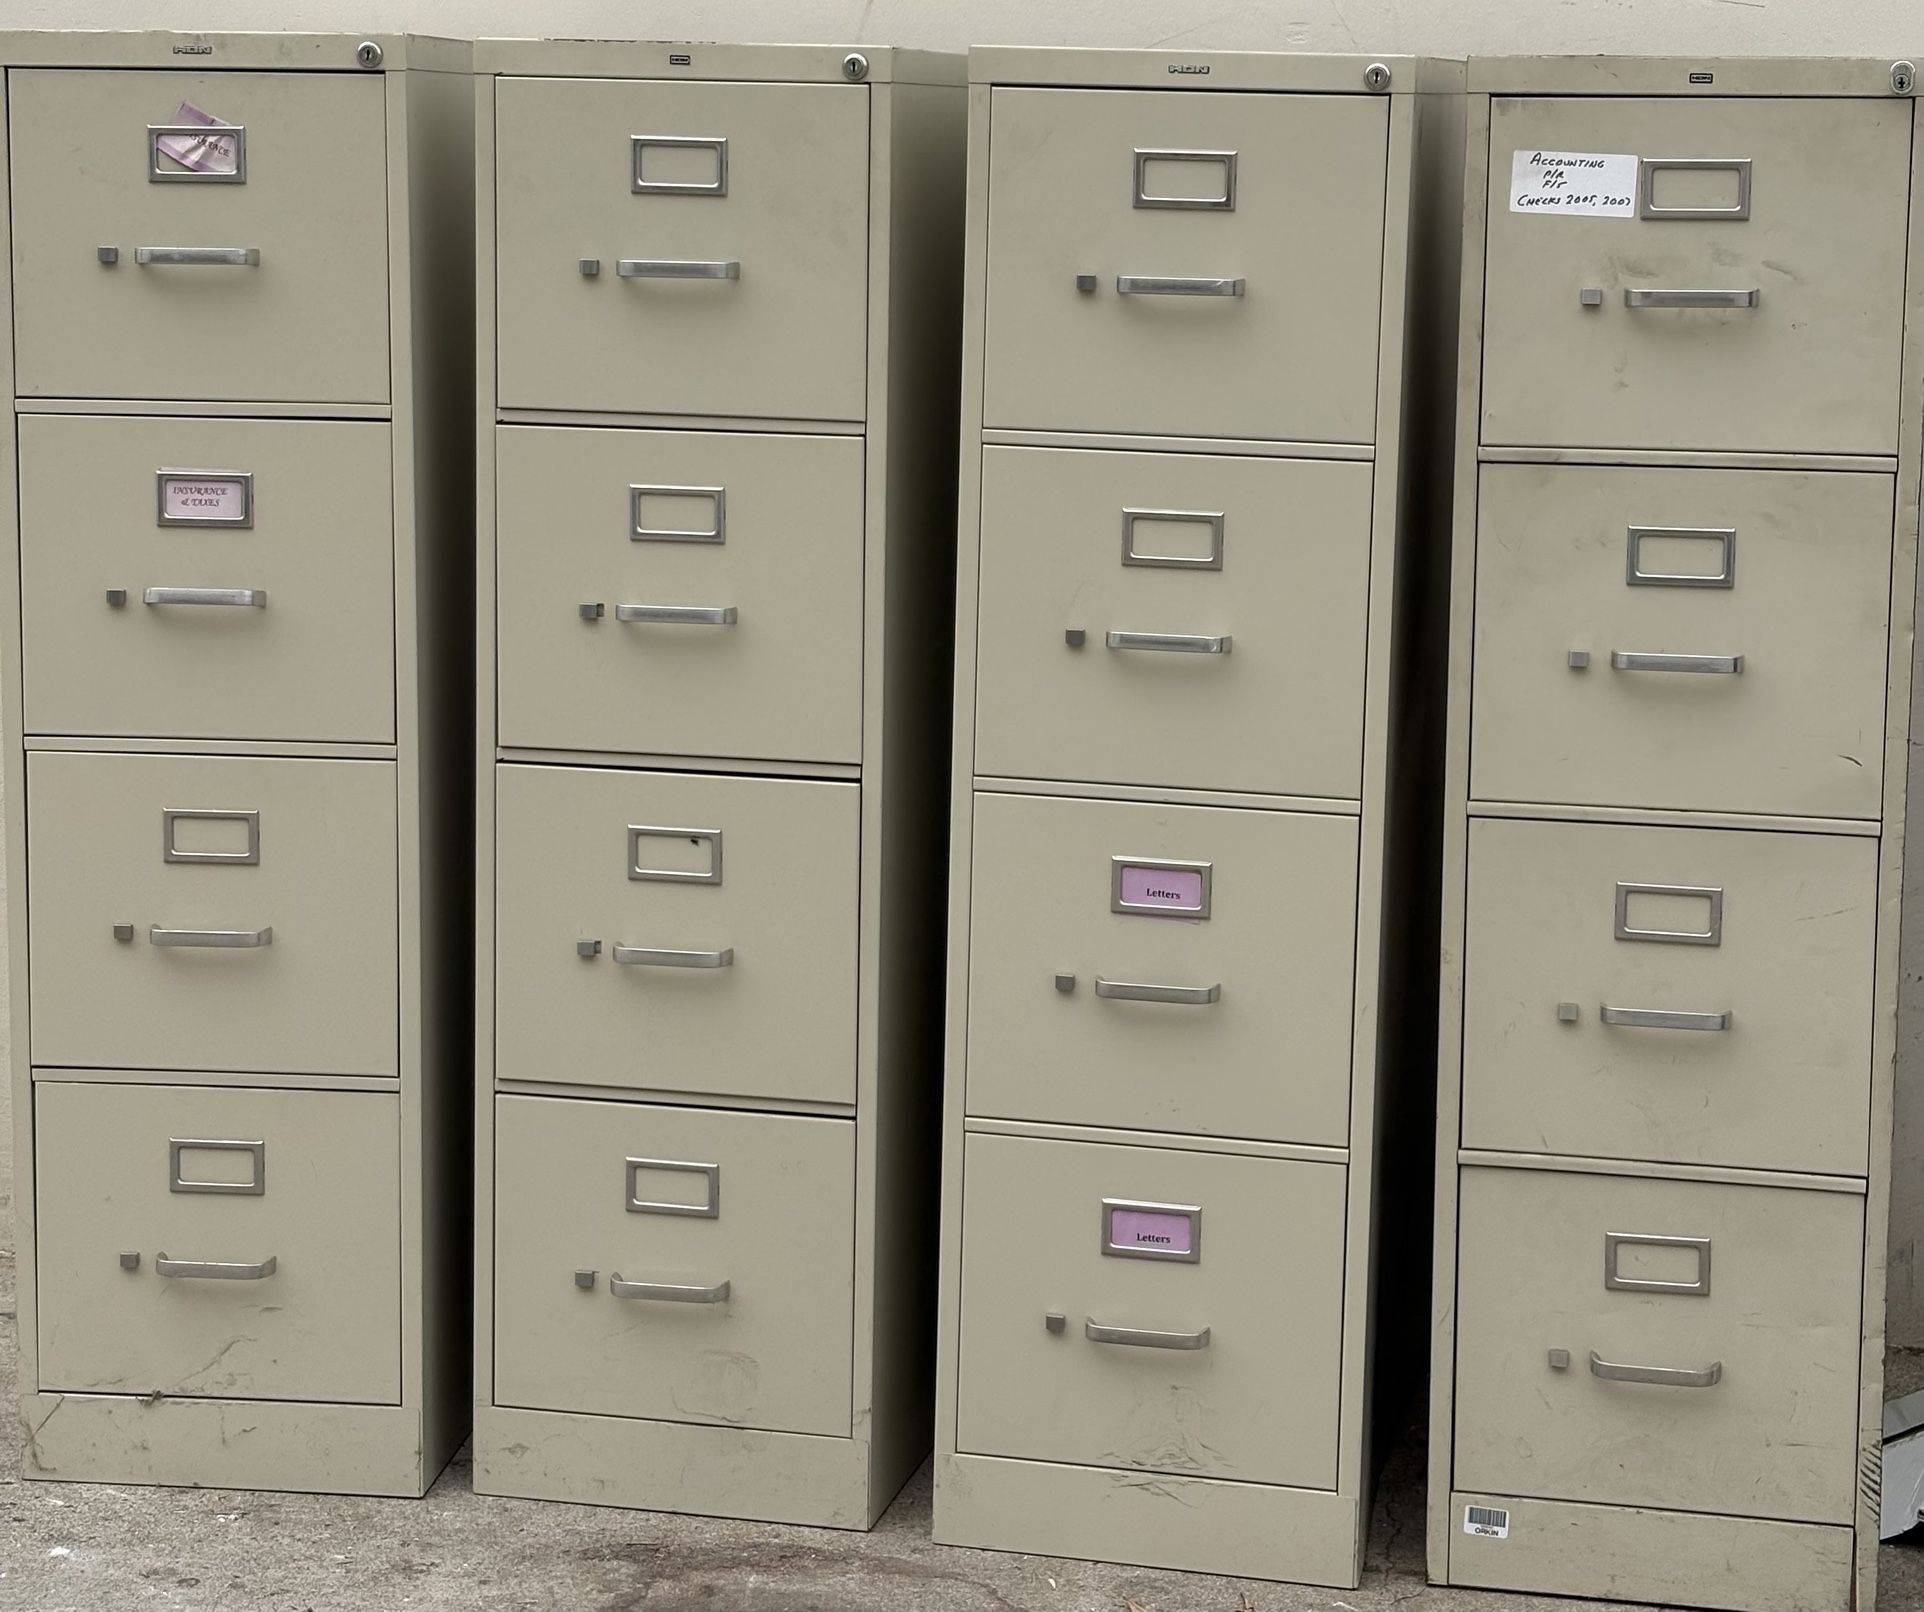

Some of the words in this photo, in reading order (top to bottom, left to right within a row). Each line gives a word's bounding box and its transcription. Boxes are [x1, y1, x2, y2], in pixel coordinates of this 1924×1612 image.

[1168, 65, 1210, 74] HON
[173, 486, 228, 496] INSURANCE
[1146, 888, 1181, 900] Letters
[1136, 1232, 1171, 1244] Letters
